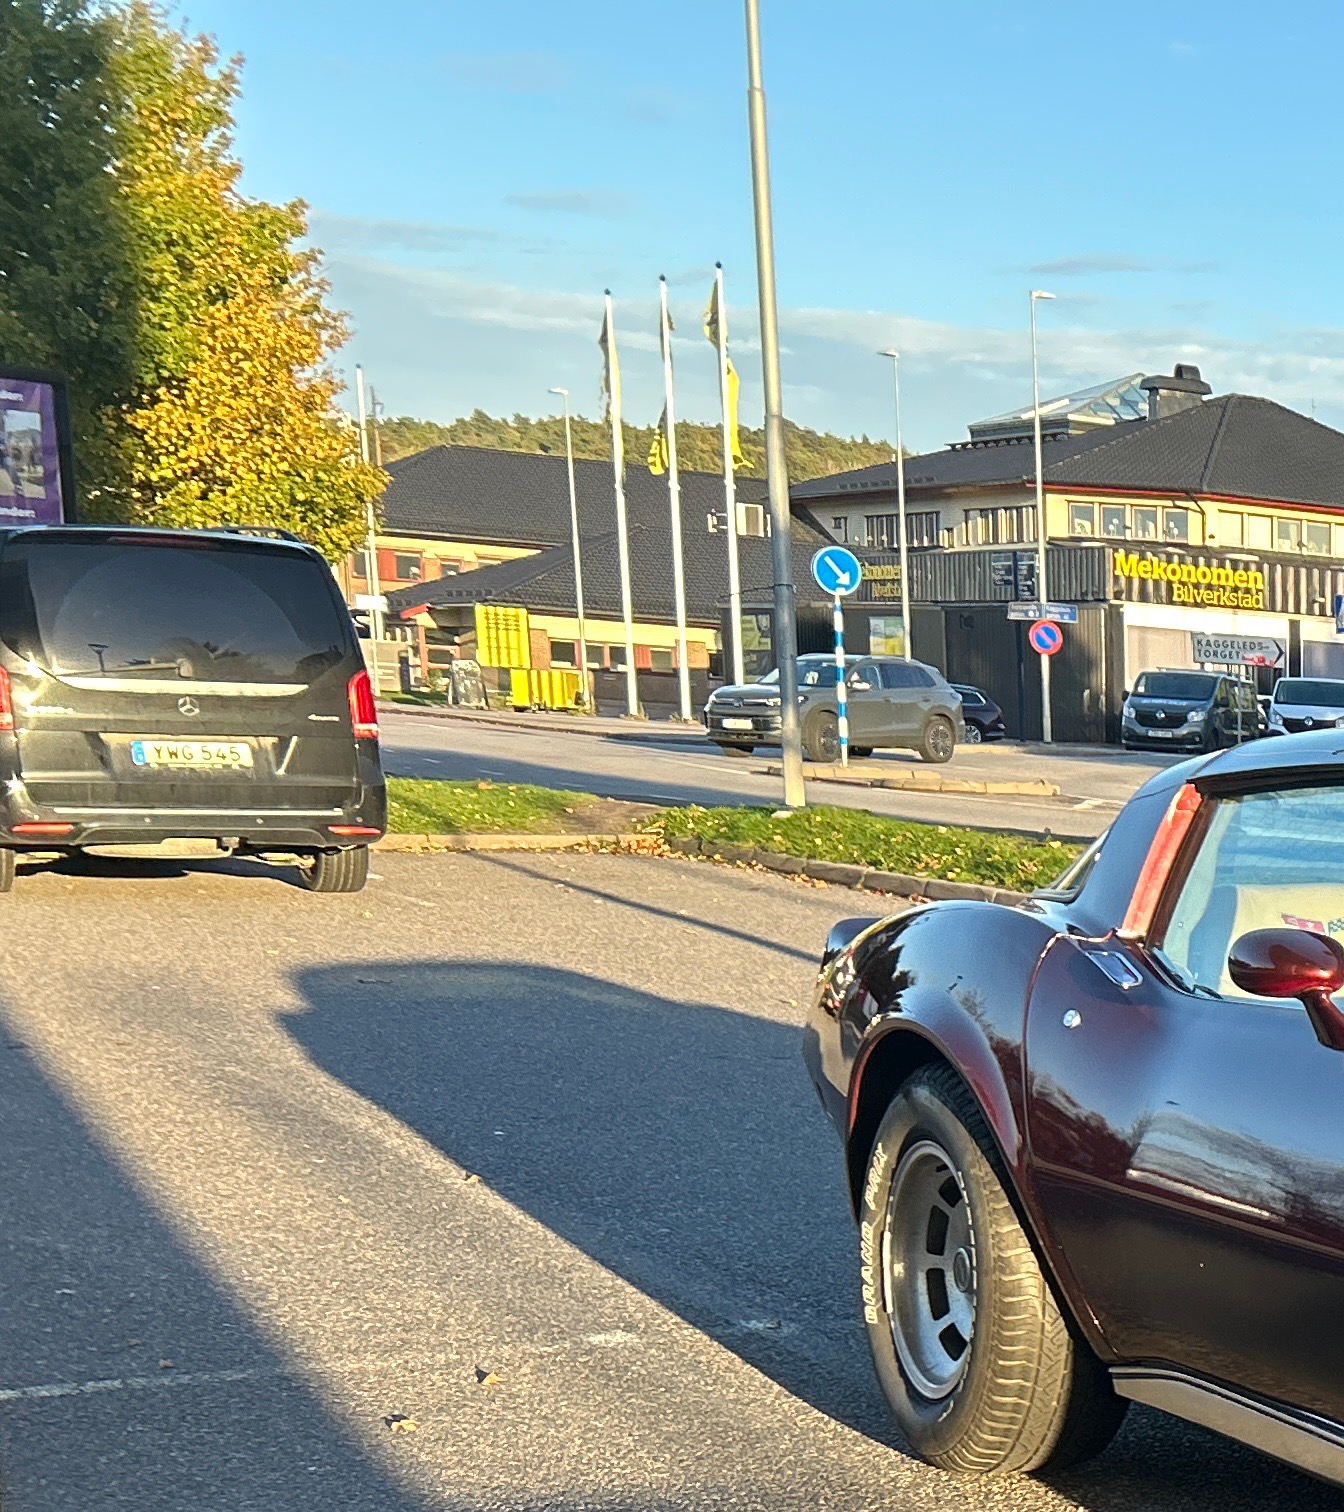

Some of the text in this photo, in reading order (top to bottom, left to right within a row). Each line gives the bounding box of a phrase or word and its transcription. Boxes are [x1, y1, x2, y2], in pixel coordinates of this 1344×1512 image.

[1114, 551, 1264, 589] Mekonomen
[1172, 584, 1263, 609] Bilverkstad
[1197, 638, 1270, 651] KAGGELEDS-
[1198, 649, 1240, 660] TORGET
[153, 745, 241, 762] YWG 545
